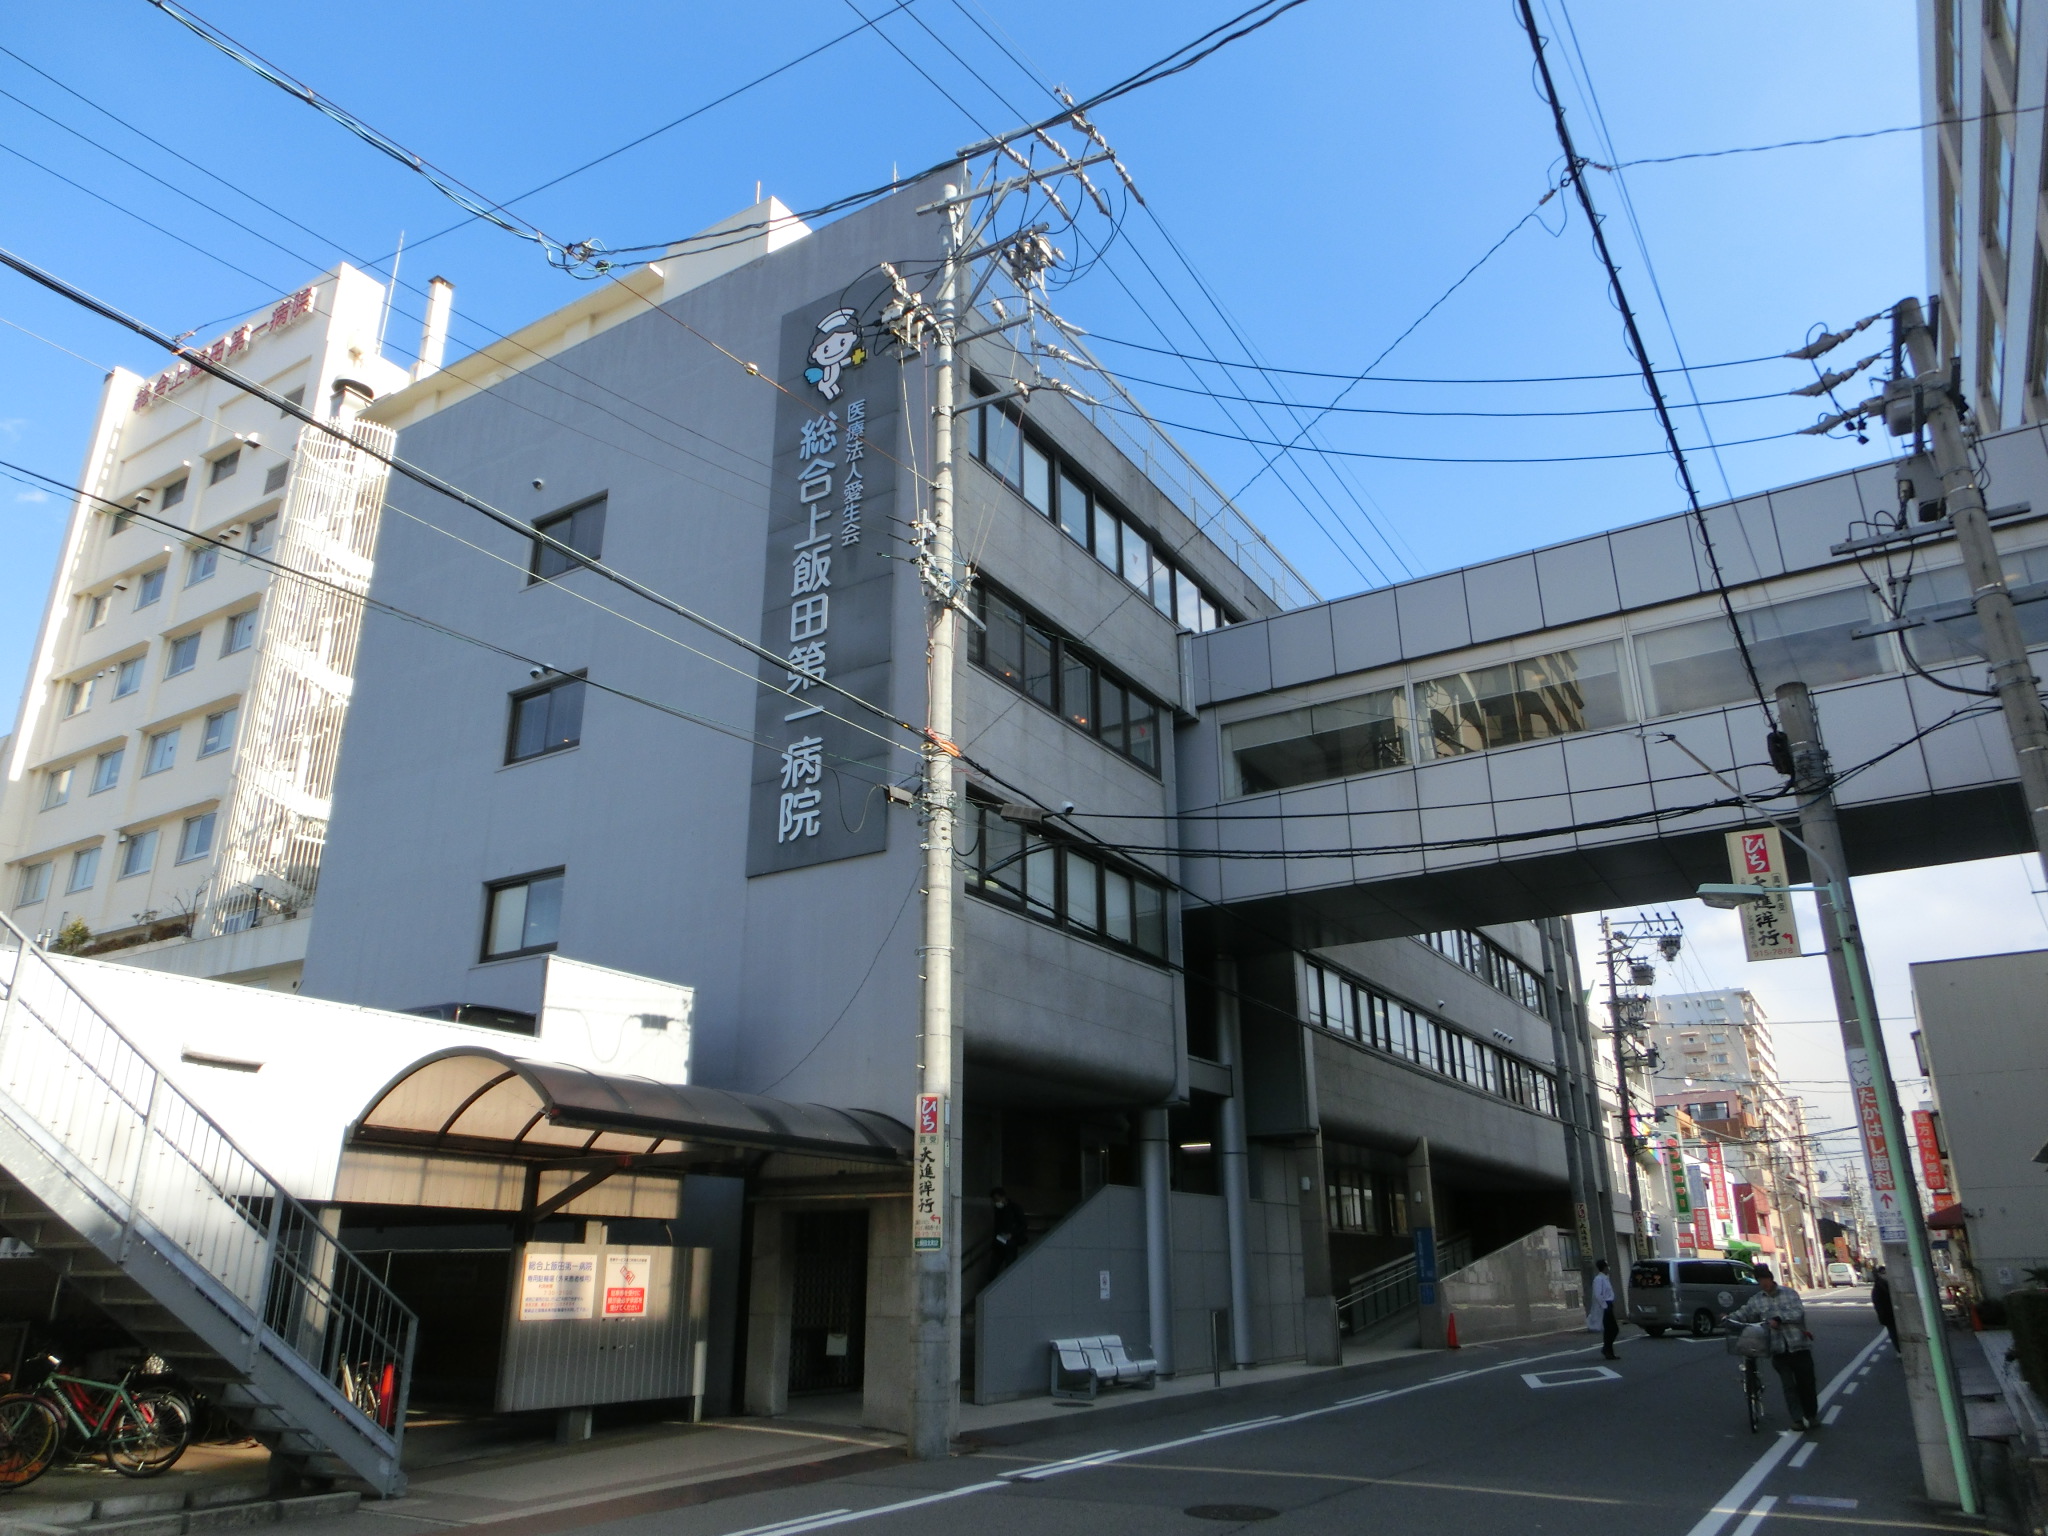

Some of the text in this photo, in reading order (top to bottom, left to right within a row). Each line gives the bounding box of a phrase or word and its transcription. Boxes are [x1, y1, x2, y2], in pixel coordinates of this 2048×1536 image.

[133, 286, 315, 412] 総合上飯田第一病院
[841, 398, 867, 547] 医療法人愛生会
[777, 411, 838, 844] 総合上飯田第一病院
[1744, 837, 1767, 871] ひち
[1753, 947, 1794, 958] 915-7878
[921, 1098, 937, 1132] ひち
[1858, 1088, 1895, 1190] たかはし歯科
[1915, 1113, 1943, 1187] 処方せん受付
[918, 1146, 936, 1213] 大進洋行
[528, 1261, 593, 1271] 総合上飯田第一病院
